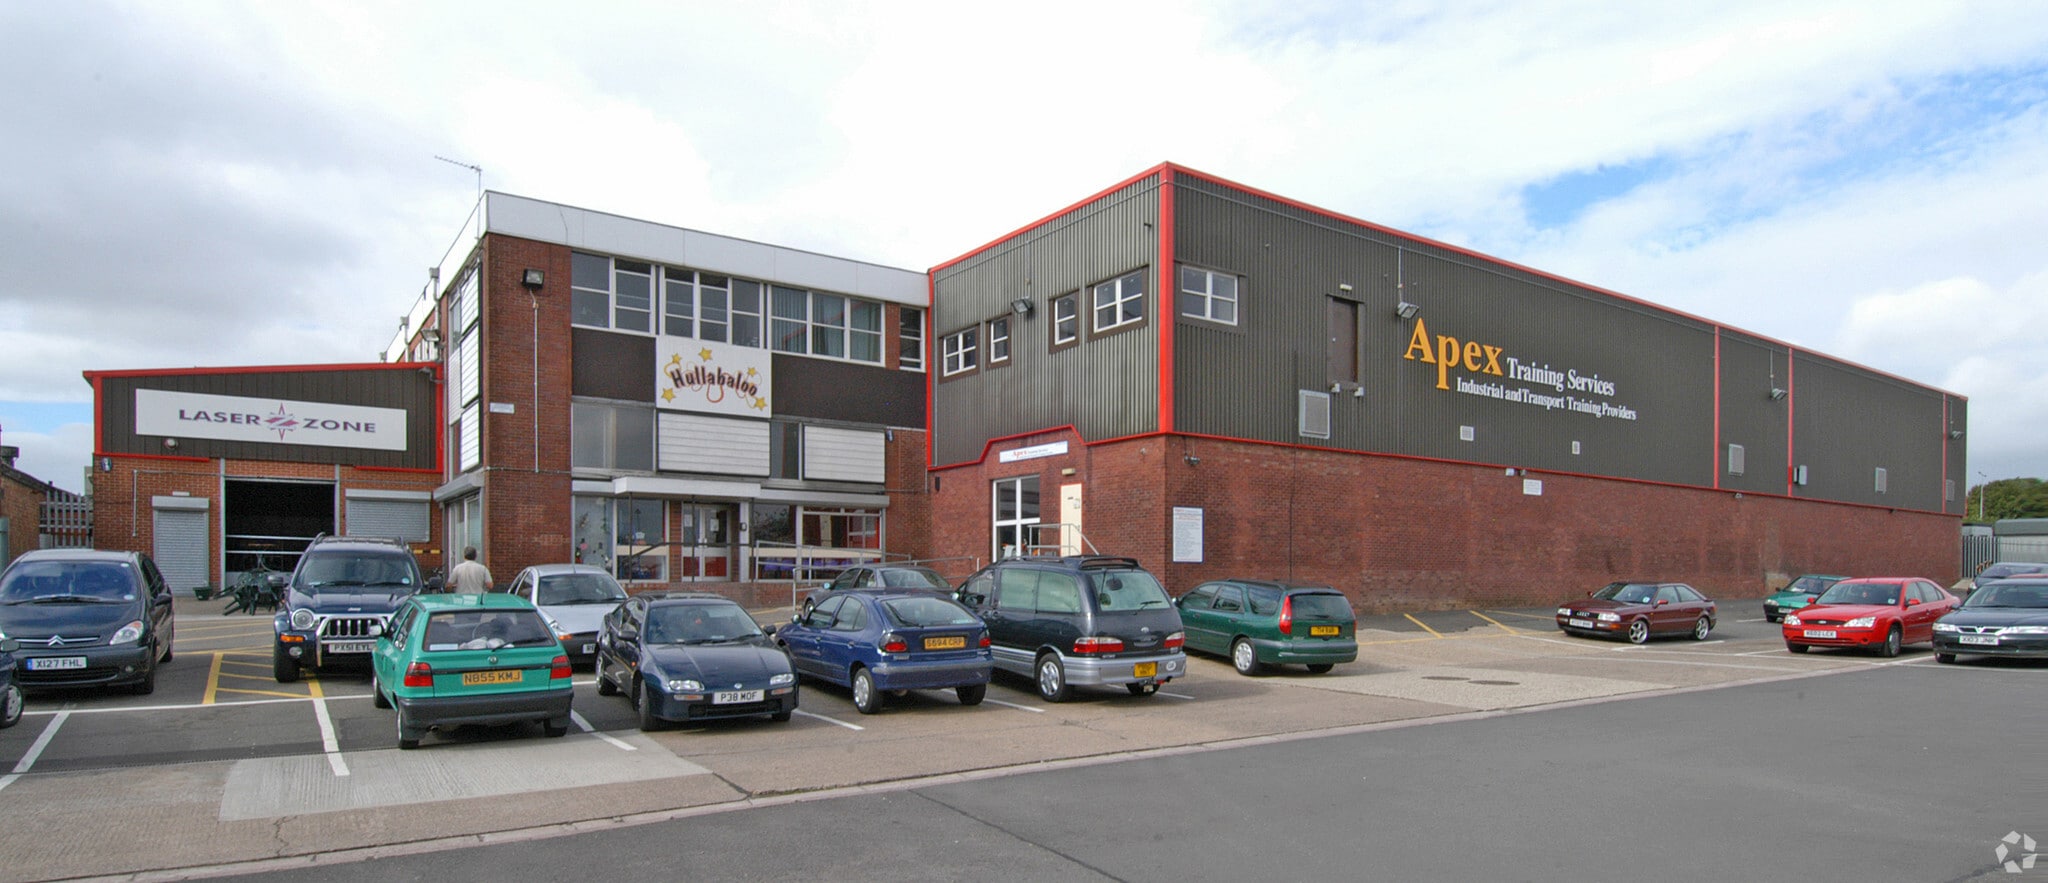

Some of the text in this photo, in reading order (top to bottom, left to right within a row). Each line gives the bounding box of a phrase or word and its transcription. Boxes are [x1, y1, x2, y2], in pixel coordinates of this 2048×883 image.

[1403, 317, 1615, 396] Apex Training Services
[670, 365, 758, 396] Hullabaloo
[1456, 376, 1637, 420] Industrial and Transport Training Providers
[179, 409, 376, 433] LASER ZONE
[334, 643, 354, 651] PX51
[35, 657, 82, 668] X127 FHL
[464, 671, 521, 684] N855 KMJ
[720, 692, 738, 702] P38
